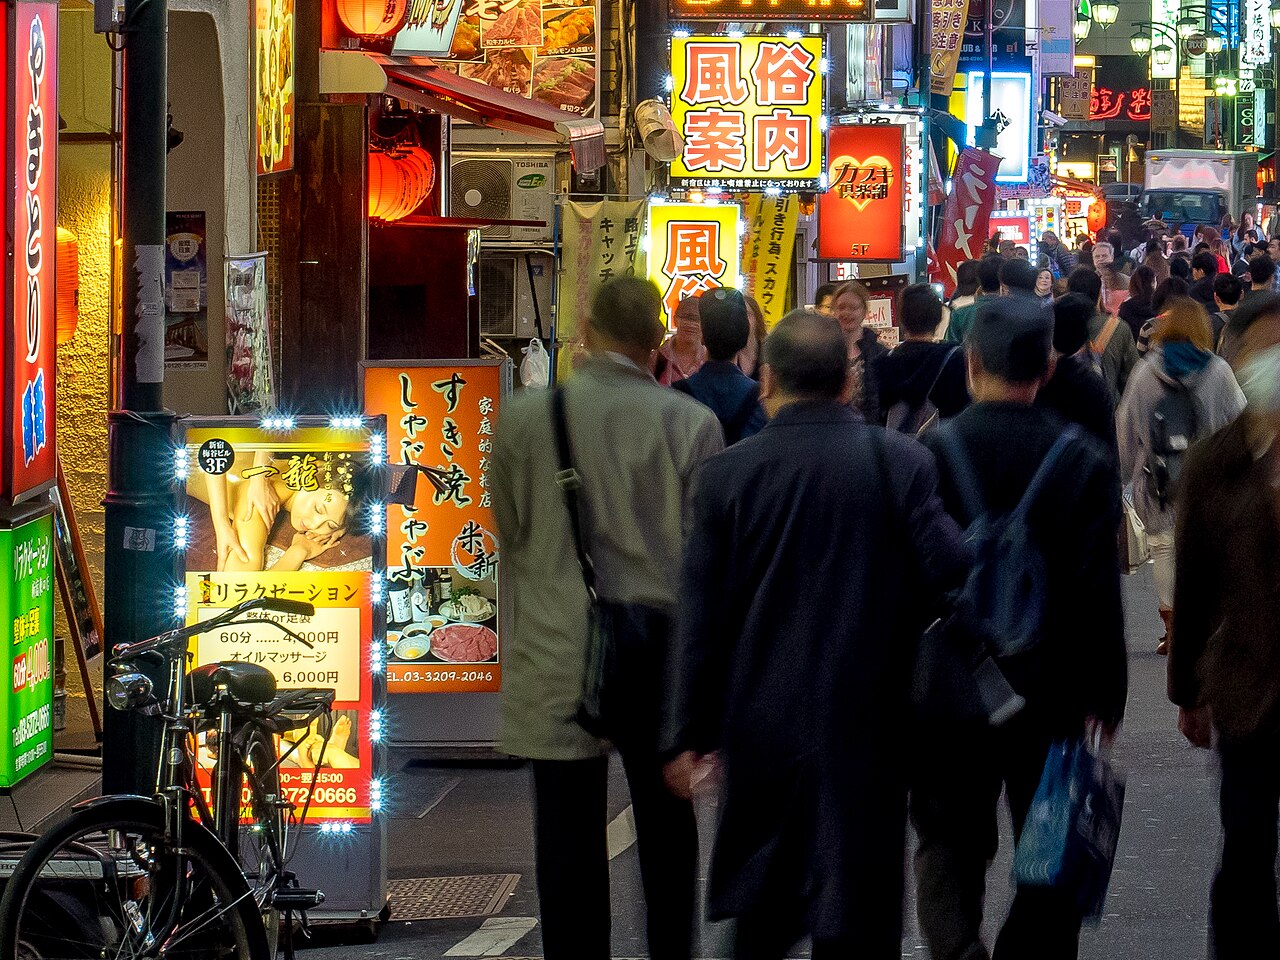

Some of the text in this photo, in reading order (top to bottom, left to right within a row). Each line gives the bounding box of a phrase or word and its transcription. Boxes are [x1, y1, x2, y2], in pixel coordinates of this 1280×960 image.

[683, 41, 814, 107] 風俗
[683, 108, 813, 173] 案内
[26, 13, 46, 364] やきとり
[850, 243, 870, 256] 5F
[208, 440, 225, 450] 新宿
[432, 372, 473, 510] すき焼
[205, 458, 229, 474] 3F
[241, 453, 321, 493] 一龍
[456, 519, 499, 581] 米新
[220, 630, 340, 644] 60分 4,000円
[230, 650, 328, 665] オイルマッサージ
[282, 671, 340, 686] 6,000円
